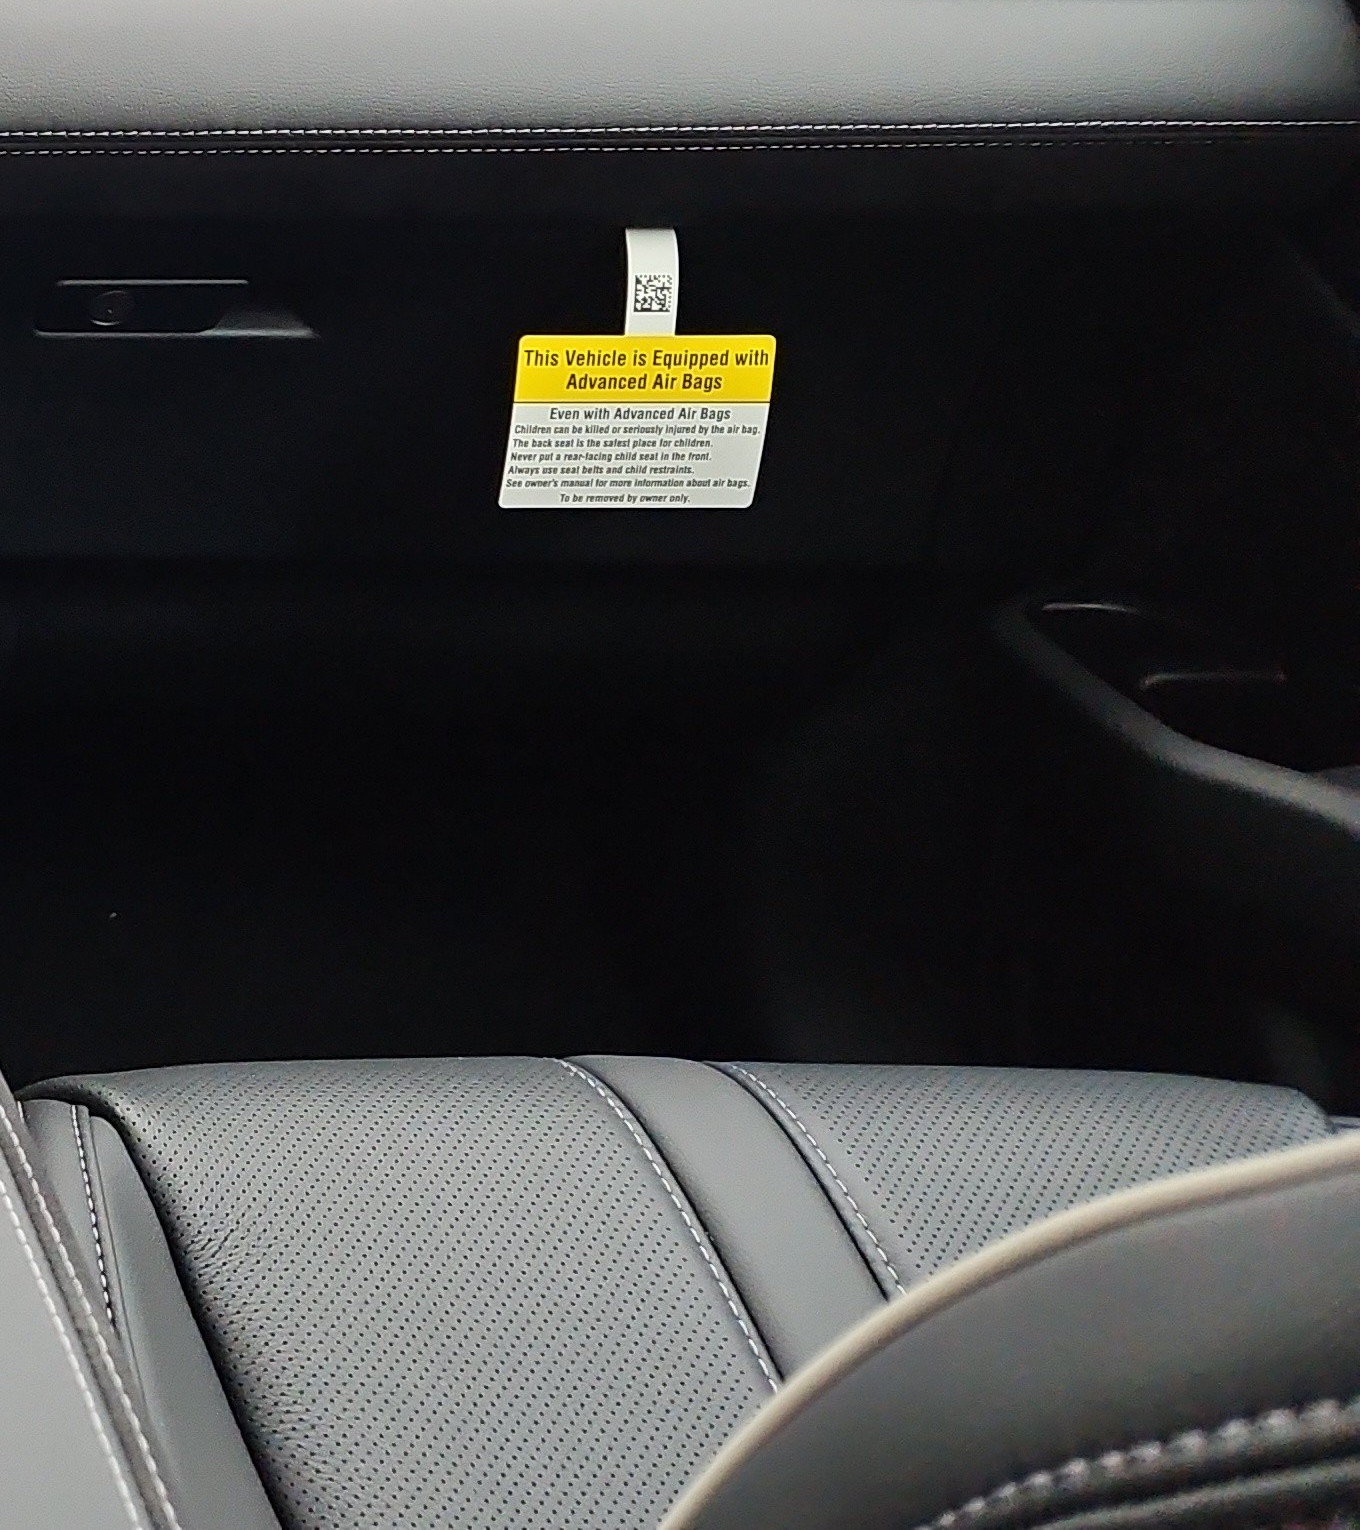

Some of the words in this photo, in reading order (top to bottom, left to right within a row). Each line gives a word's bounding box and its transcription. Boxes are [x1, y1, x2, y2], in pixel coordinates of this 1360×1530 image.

[524, 350, 559, 366] This
[565, 350, 626, 366] Vehicle
[633, 350, 647, 366] is
[652, 350, 730, 370] Equipped
[735, 349, 769, 366] with
[566, 373, 647, 390] Advanced
[652, 373, 678, 390] Air
[682, 373, 723, 392] Bags
[550, 407, 580, 420] Even
[584, 407, 610, 420] with
[613, 407, 675, 420] Advanced
[678, 407, 697, 420] Air
[700, 407, 731, 422] Bags
[514, 425, 551, 434] Children
[554, 426, 569, 434] can
[572, 425, 583, 434] be
[585, 425, 610, 434] killed
[611, 426, 621, 434] or
[623, 425, 664, 435] seriously
[665, 425, 696, 435] injured
[698, 425, 708, 435] by
[711, 425, 725, 434] the
[727, 425, 740, 434] air
[742, 425, 761, 435] bag.
[513, 438, 529, 447] The
[532, 438, 552, 447] back
[555, 438, 574, 447] seat
[576, 438, 584, 447] is
[587, 438, 600, 447] the
[603, 438, 630, 447] safest
[632, 439, 656, 449] place
[660, 438, 672, 447] for
[674, 438, 713, 447] children.
[510, 452, 537, 461] Never
[539, 452, 554, 463] put
[564, 452, 612, 463] rear-facing
[615, 452, 636, 461] child
[639, 452, 658, 461] seat
[661, 452, 670, 461] in
[672, 452, 685, 461] the
[688, 452, 712, 461] front.
[508, 466, 539, 476] Always
[560, 466, 580, 474] seat
[582, 466, 603, 474] belts
[606, 466, 623, 474] and
[625, 466, 647, 474] child
[650, 466, 695, 474] restraints.
[506, 479, 522, 487] See
[525, 479, 558, 487] owner's
[561, 479, 593, 487] manual
[596, 479, 607, 487] for
[634, 479, 684, 487] information
[686, 479, 710, 487] about
[712, 479, 725, 487] air
[727, 479, 751, 488] bags.
[560, 494, 570, 502] To
[573, 494, 583, 502] be
[586, 494, 624, 502] removed
[627, 494, 637, 504] by
[670, 494, 691, 504] only.
